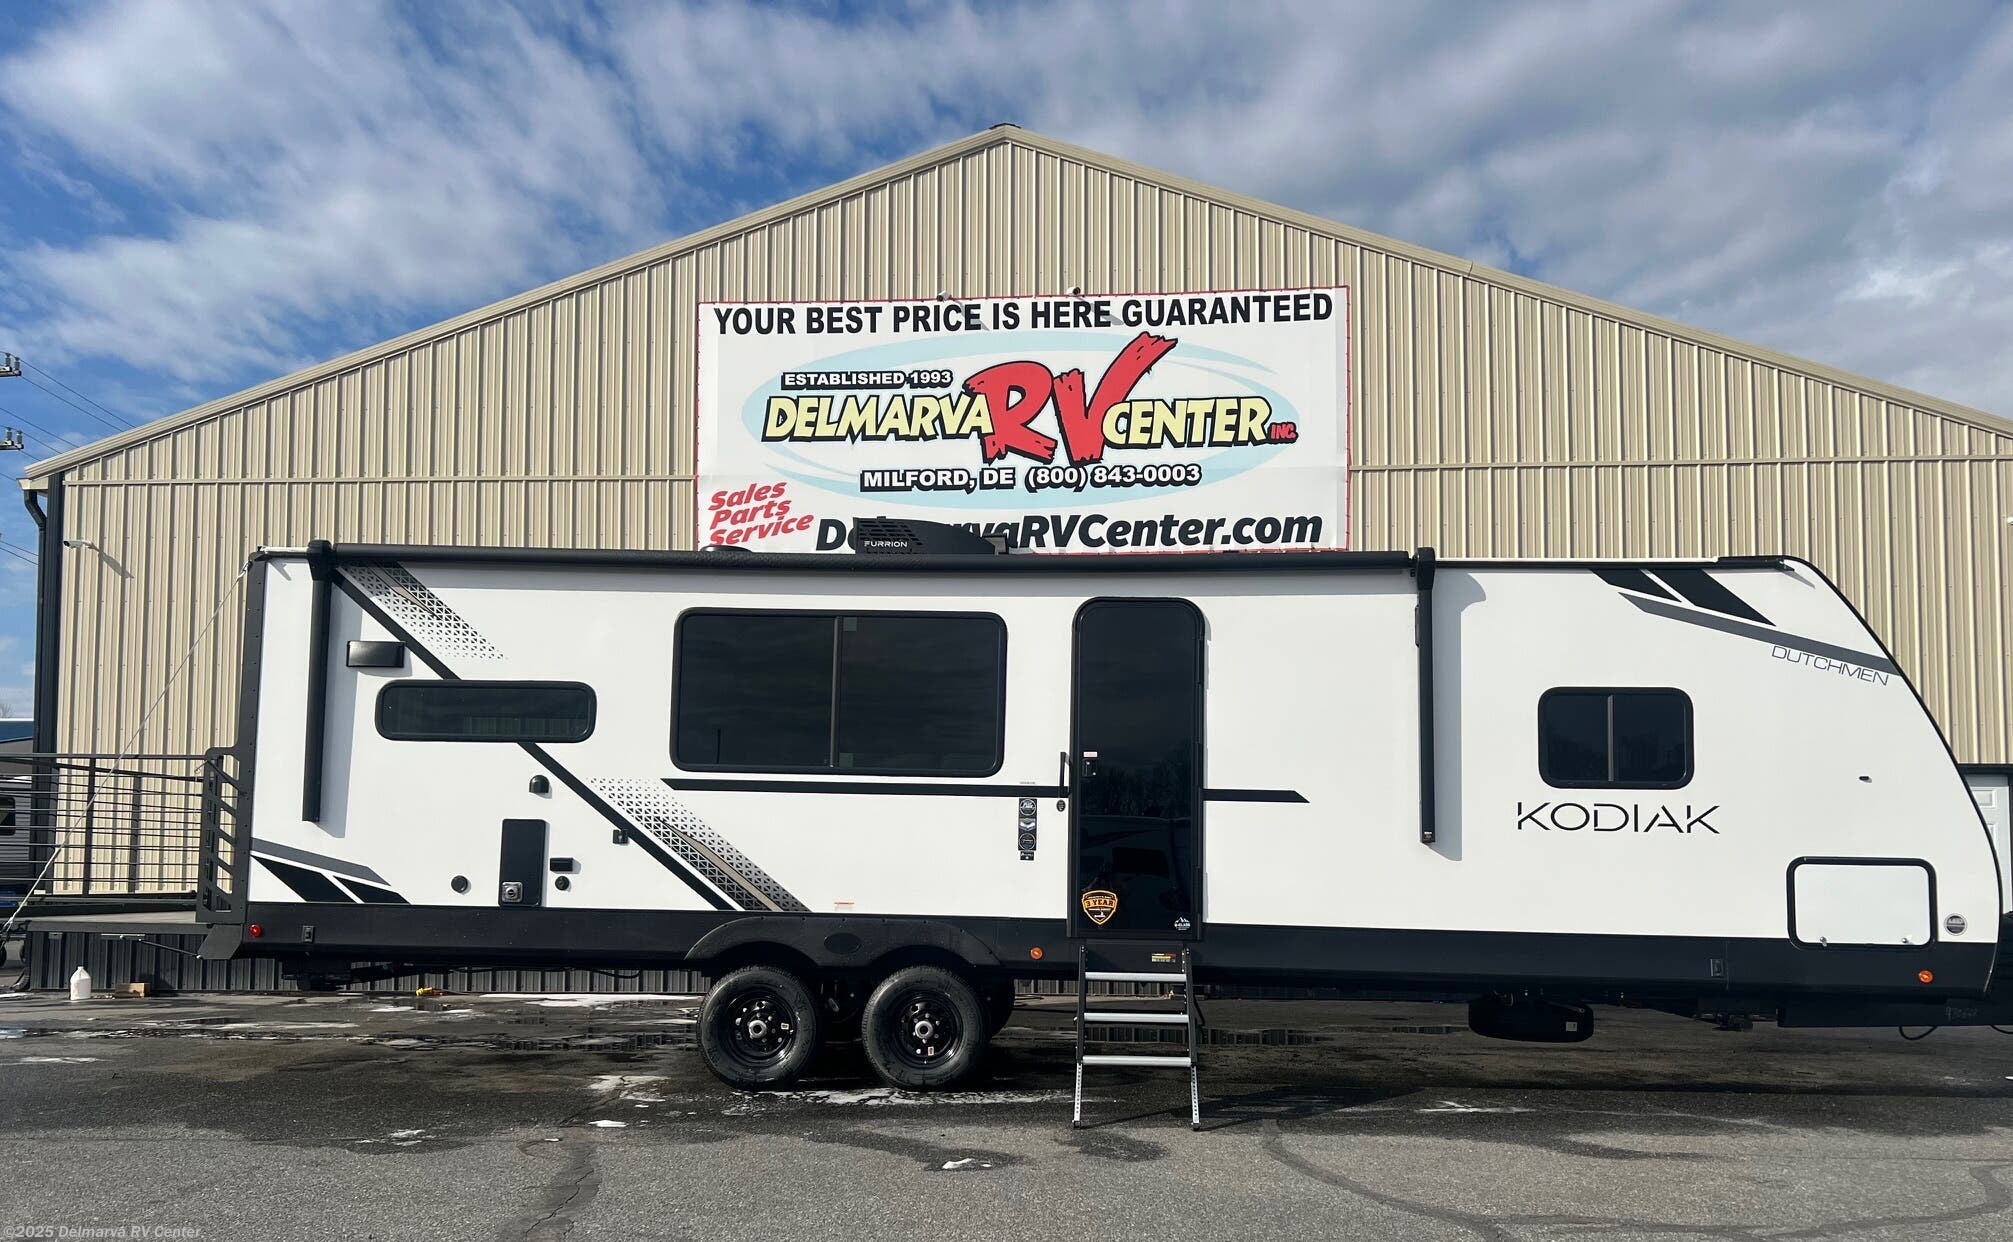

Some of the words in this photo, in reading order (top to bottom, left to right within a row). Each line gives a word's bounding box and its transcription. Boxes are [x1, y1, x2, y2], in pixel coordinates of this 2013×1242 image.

[714, 306, 796, 335] YOUR
[806, 306, 883, 334] BEST
[893, 304, 982, 333] PRICE
[993, 302, 1020, 330] IS
[1030, 300, 1111, 329] HERE
[1121, 293, 1333, 327] GUARANTEED
[783, 372, 905, 387] ESTABLISHED
[909, 370, 952, 385] 1993
[763, 393, 994, 444] DELMARVA
[962, 330, 1179, 465] RV
[1102, 396, 1273, 447] CENTER
[1270, 422, 1298, 443] INC.
[861, 470, 977, 494] MILFORD,
[978, 469, 1015, 489] DE
[1027, 466, 1087, 492] (800)
[1093, 464, 1201, 487] 843-0003
[708, 481, 788, 511] Sales
[709, 499, 792, 530] Parts
[709, 513, 814, 546] Service
[864, 540, 908, 548] FURRION
[1771, 645, 1890, 687] DUTCHMEN
[1517, 801, 1721, 834] KODIAK
[1092, 899, 1114, 907] YEAR
